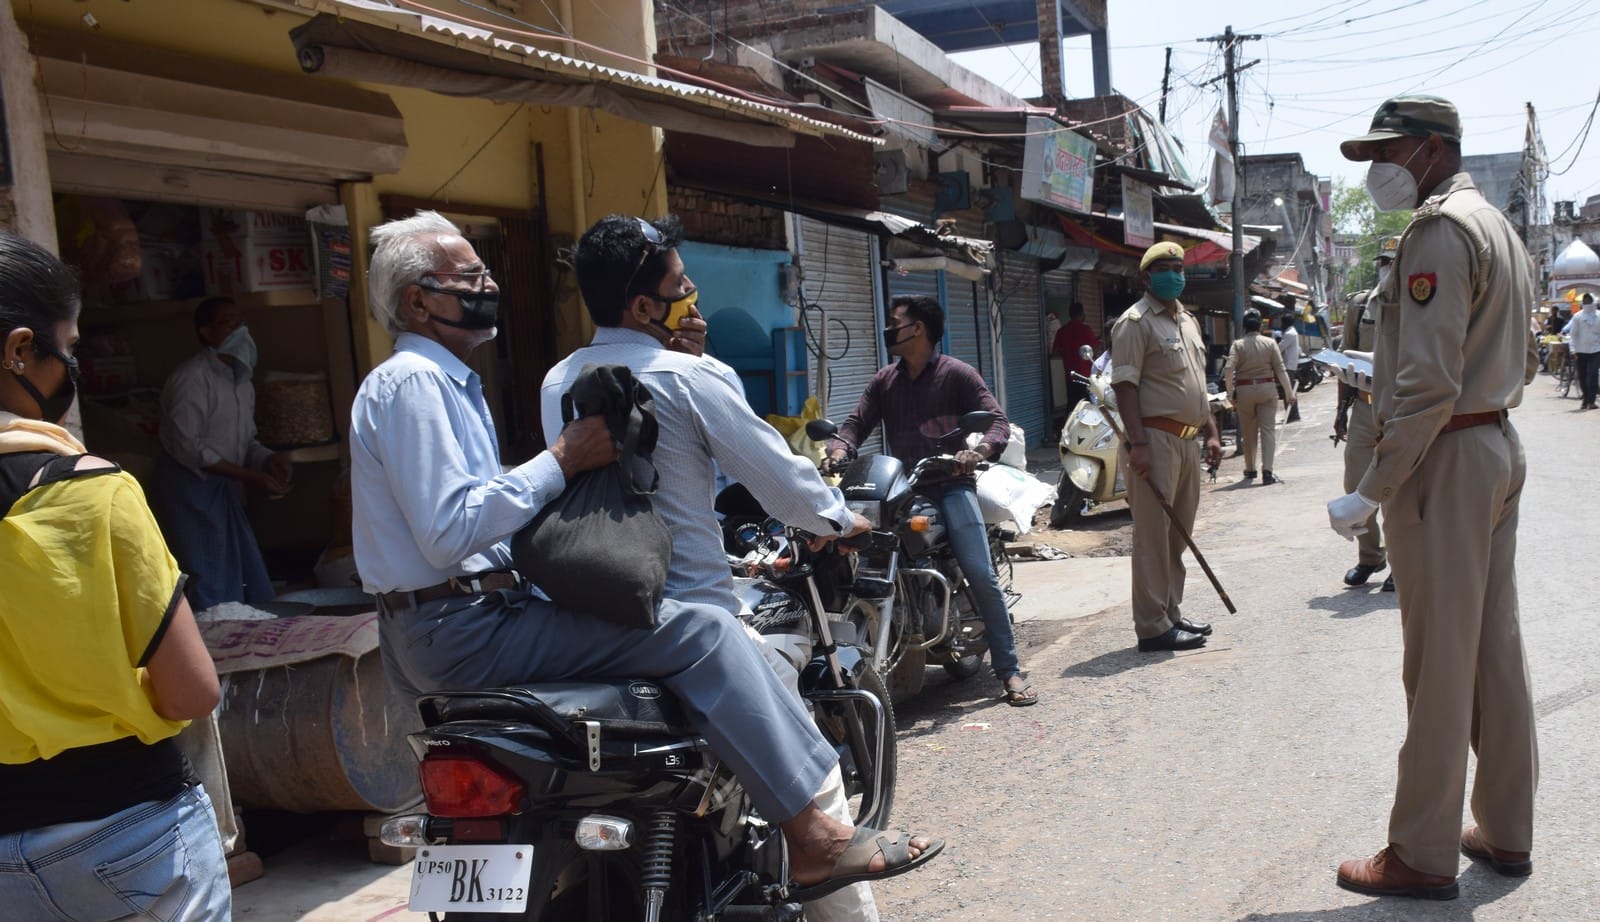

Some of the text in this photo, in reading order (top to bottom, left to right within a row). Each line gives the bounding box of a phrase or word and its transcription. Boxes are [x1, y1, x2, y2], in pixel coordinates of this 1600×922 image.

[417, 859, 523, 902] UP50 BK 3122
